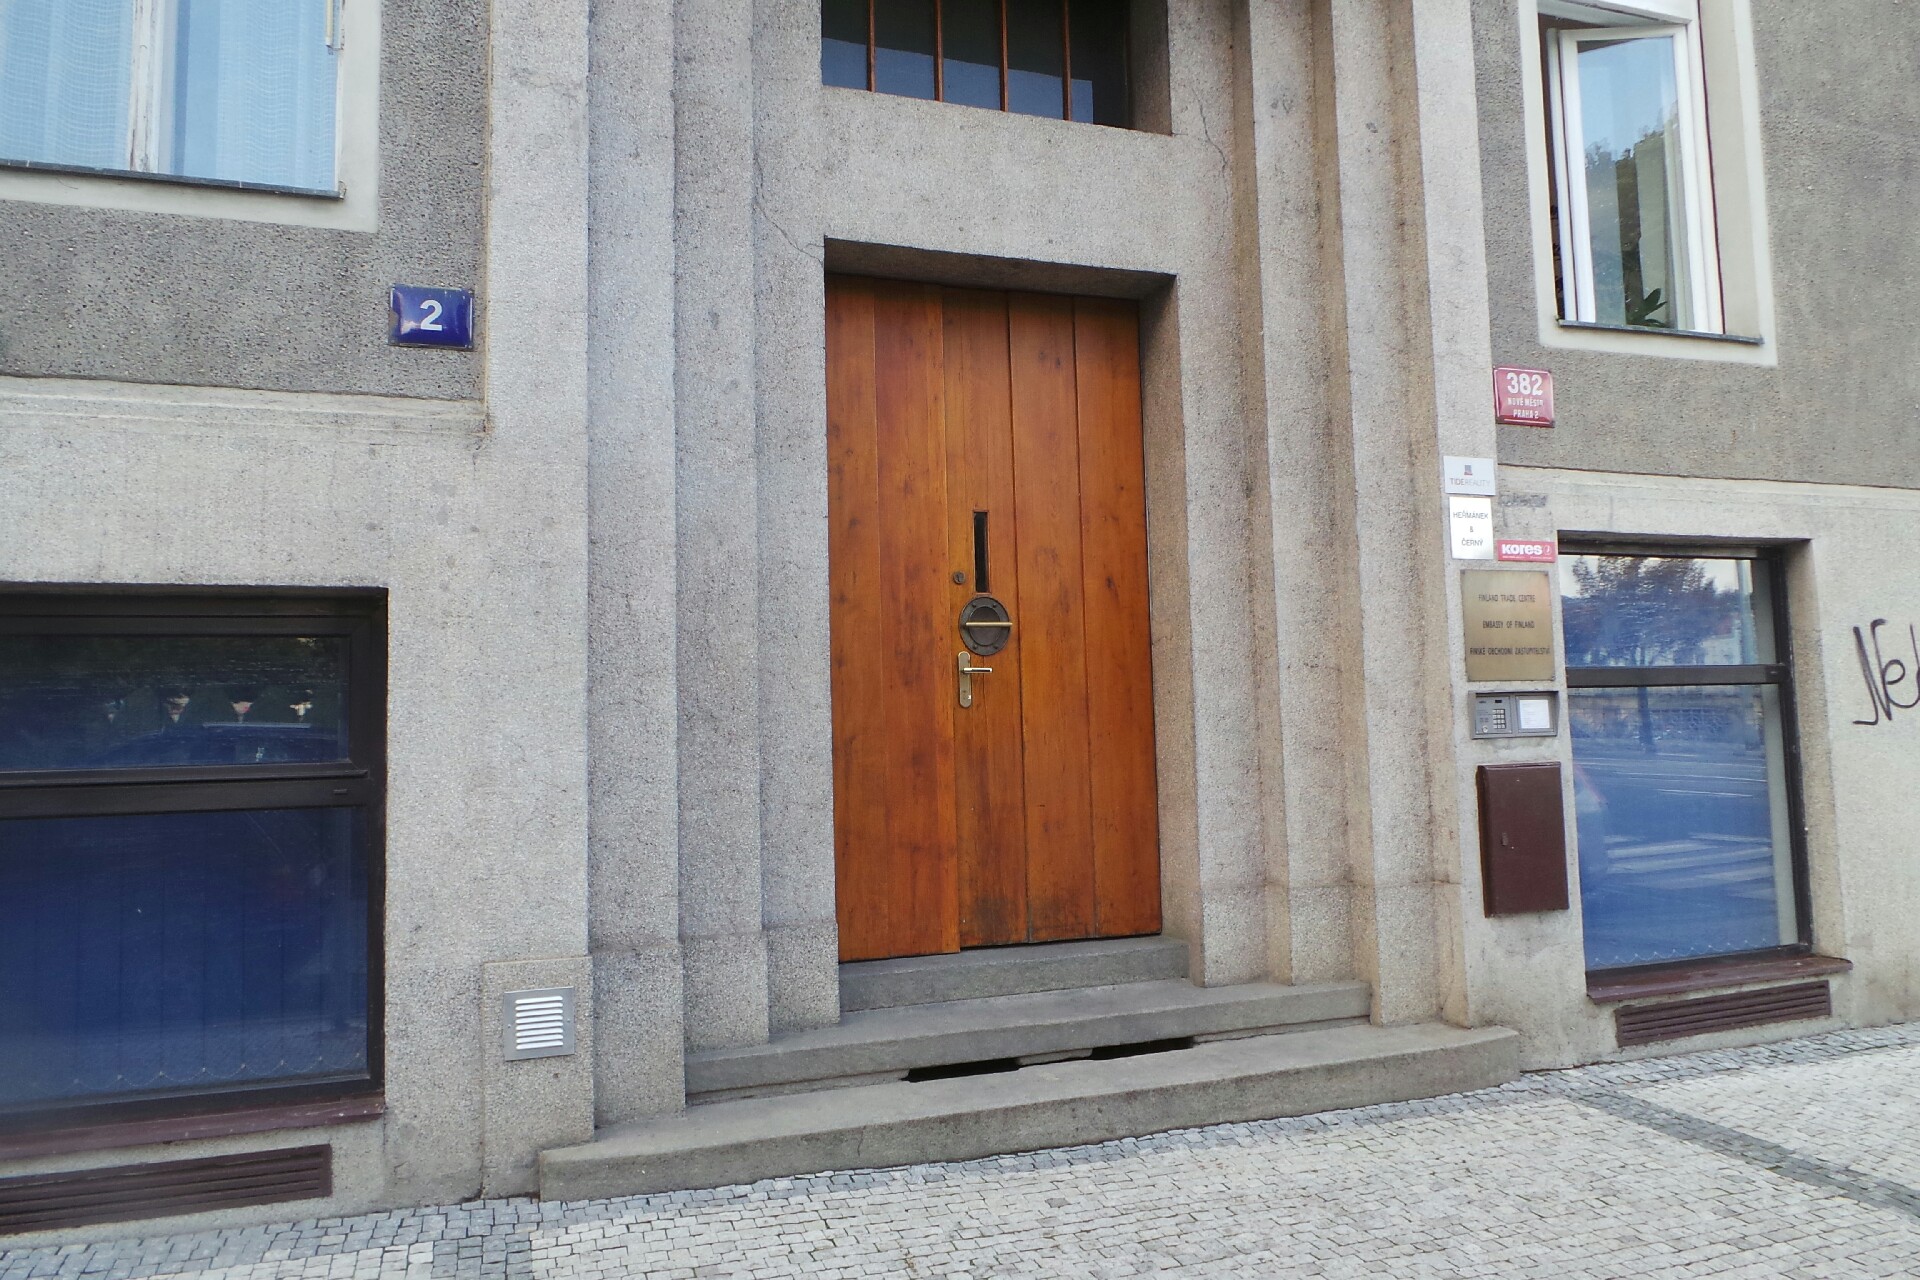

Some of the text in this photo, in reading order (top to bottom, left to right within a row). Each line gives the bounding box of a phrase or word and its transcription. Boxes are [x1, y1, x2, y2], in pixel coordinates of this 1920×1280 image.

[420, 299, 443, 332] 2
[1507, 372, 1544, 396] 382
[1513, 409, 1539, 419] PRAHA 2
[1461, 537, 1484, 547] ČERNÝ
[1478, 594, 1536, 603] FINLAND TRADE CENTRE
[1482, 620, 1535, 629] EMBASSY OF FINLAND
